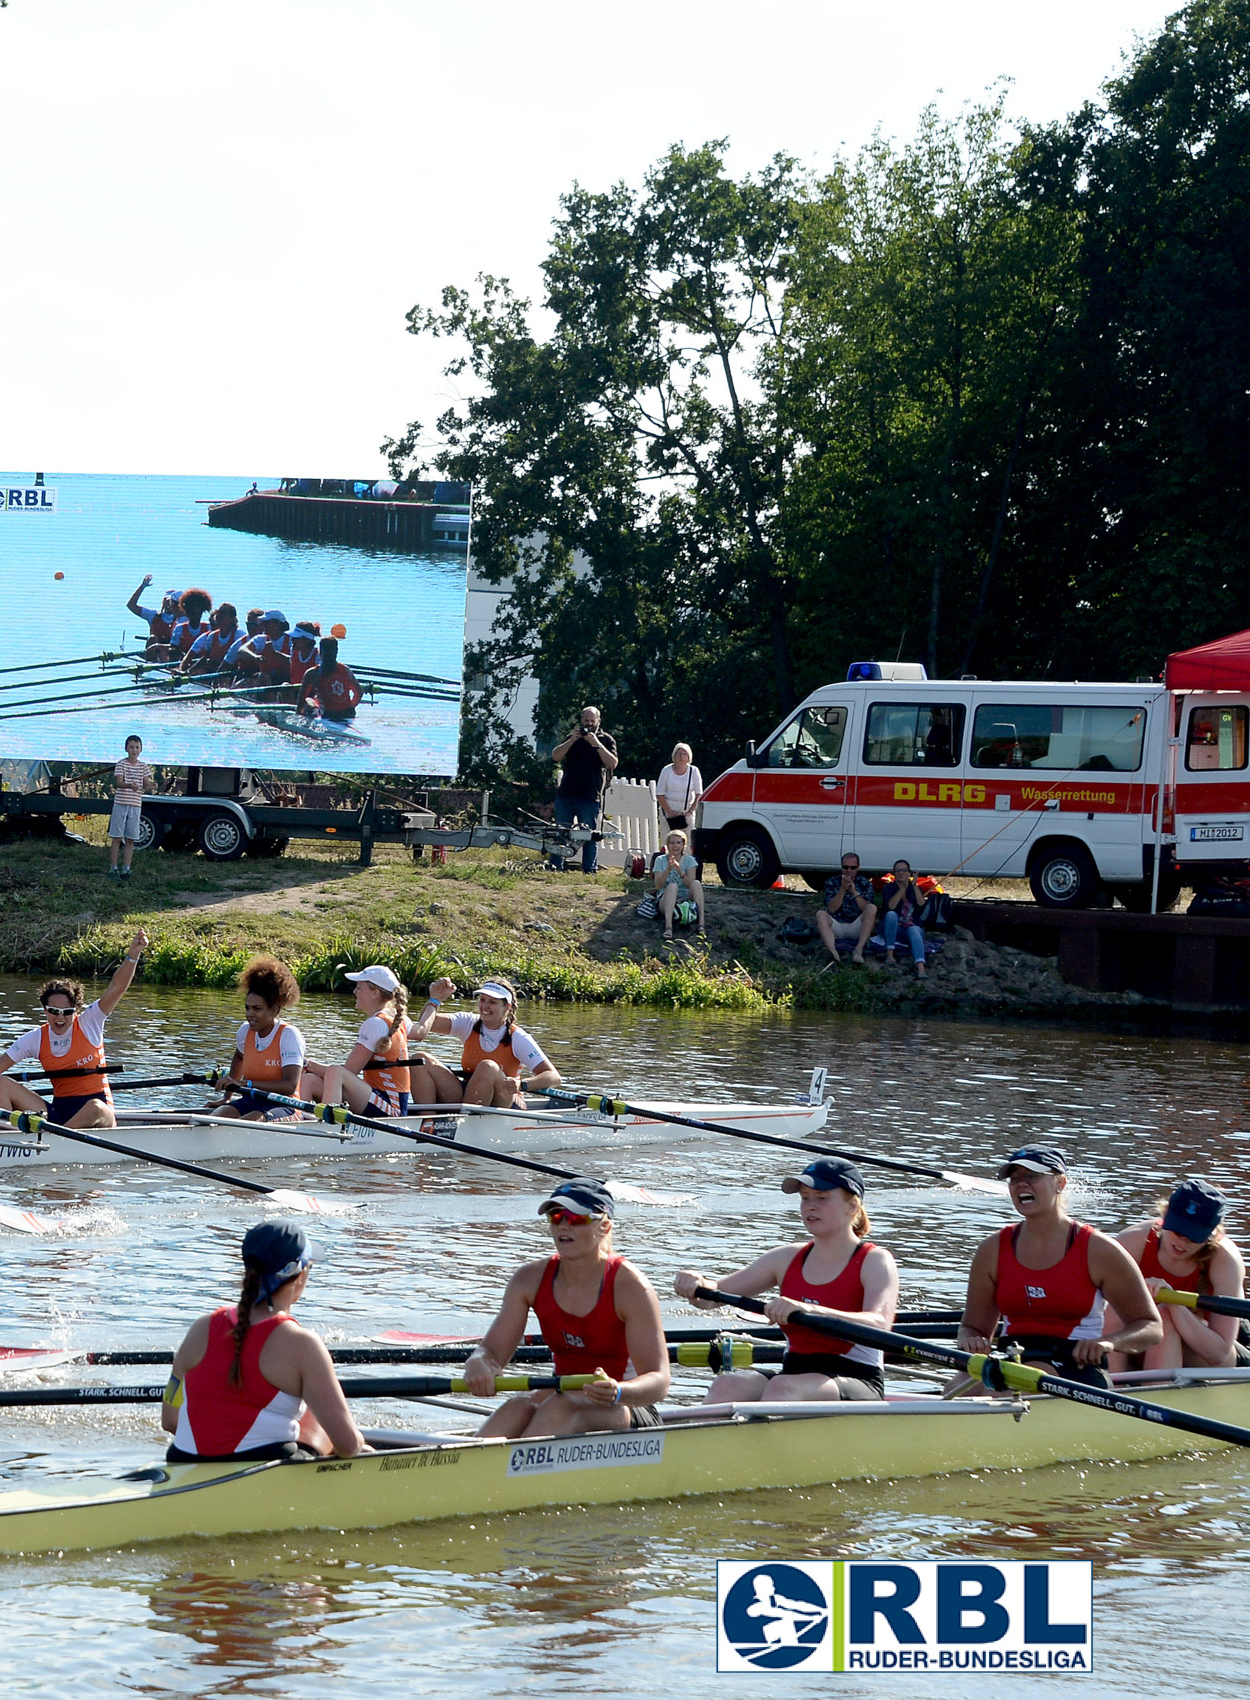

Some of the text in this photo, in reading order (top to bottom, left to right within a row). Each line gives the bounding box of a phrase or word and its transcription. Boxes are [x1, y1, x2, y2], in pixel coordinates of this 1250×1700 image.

[9, 489, 53, 506] RBL
[894, 783, 986, 802] DLRG
[1021, 787, 1116, 804] Wasserrettung
[1200, 829, 1238, 838] MI 2012
[77, 1055, 94, 1066] KRG
[815, 1070, 824, 1094] 4
[79, 1388, 108, 1397] STARK.
[109, 1388, 148, 1397] SCHNELL.
[1041, 1382, 1071, 1398] STARK.
[1072, 1389, 1115, 1409] SCHNELL.
[1115, 1401, 1136, 1415] GUT.
[526, 1439, 661, 1465] RBL RUDER-BUNDESLIGA
[316, 1463, 353, 1473] EMPACHER
[379, 1451, 461, 1472] Hanauer RC Hassia
